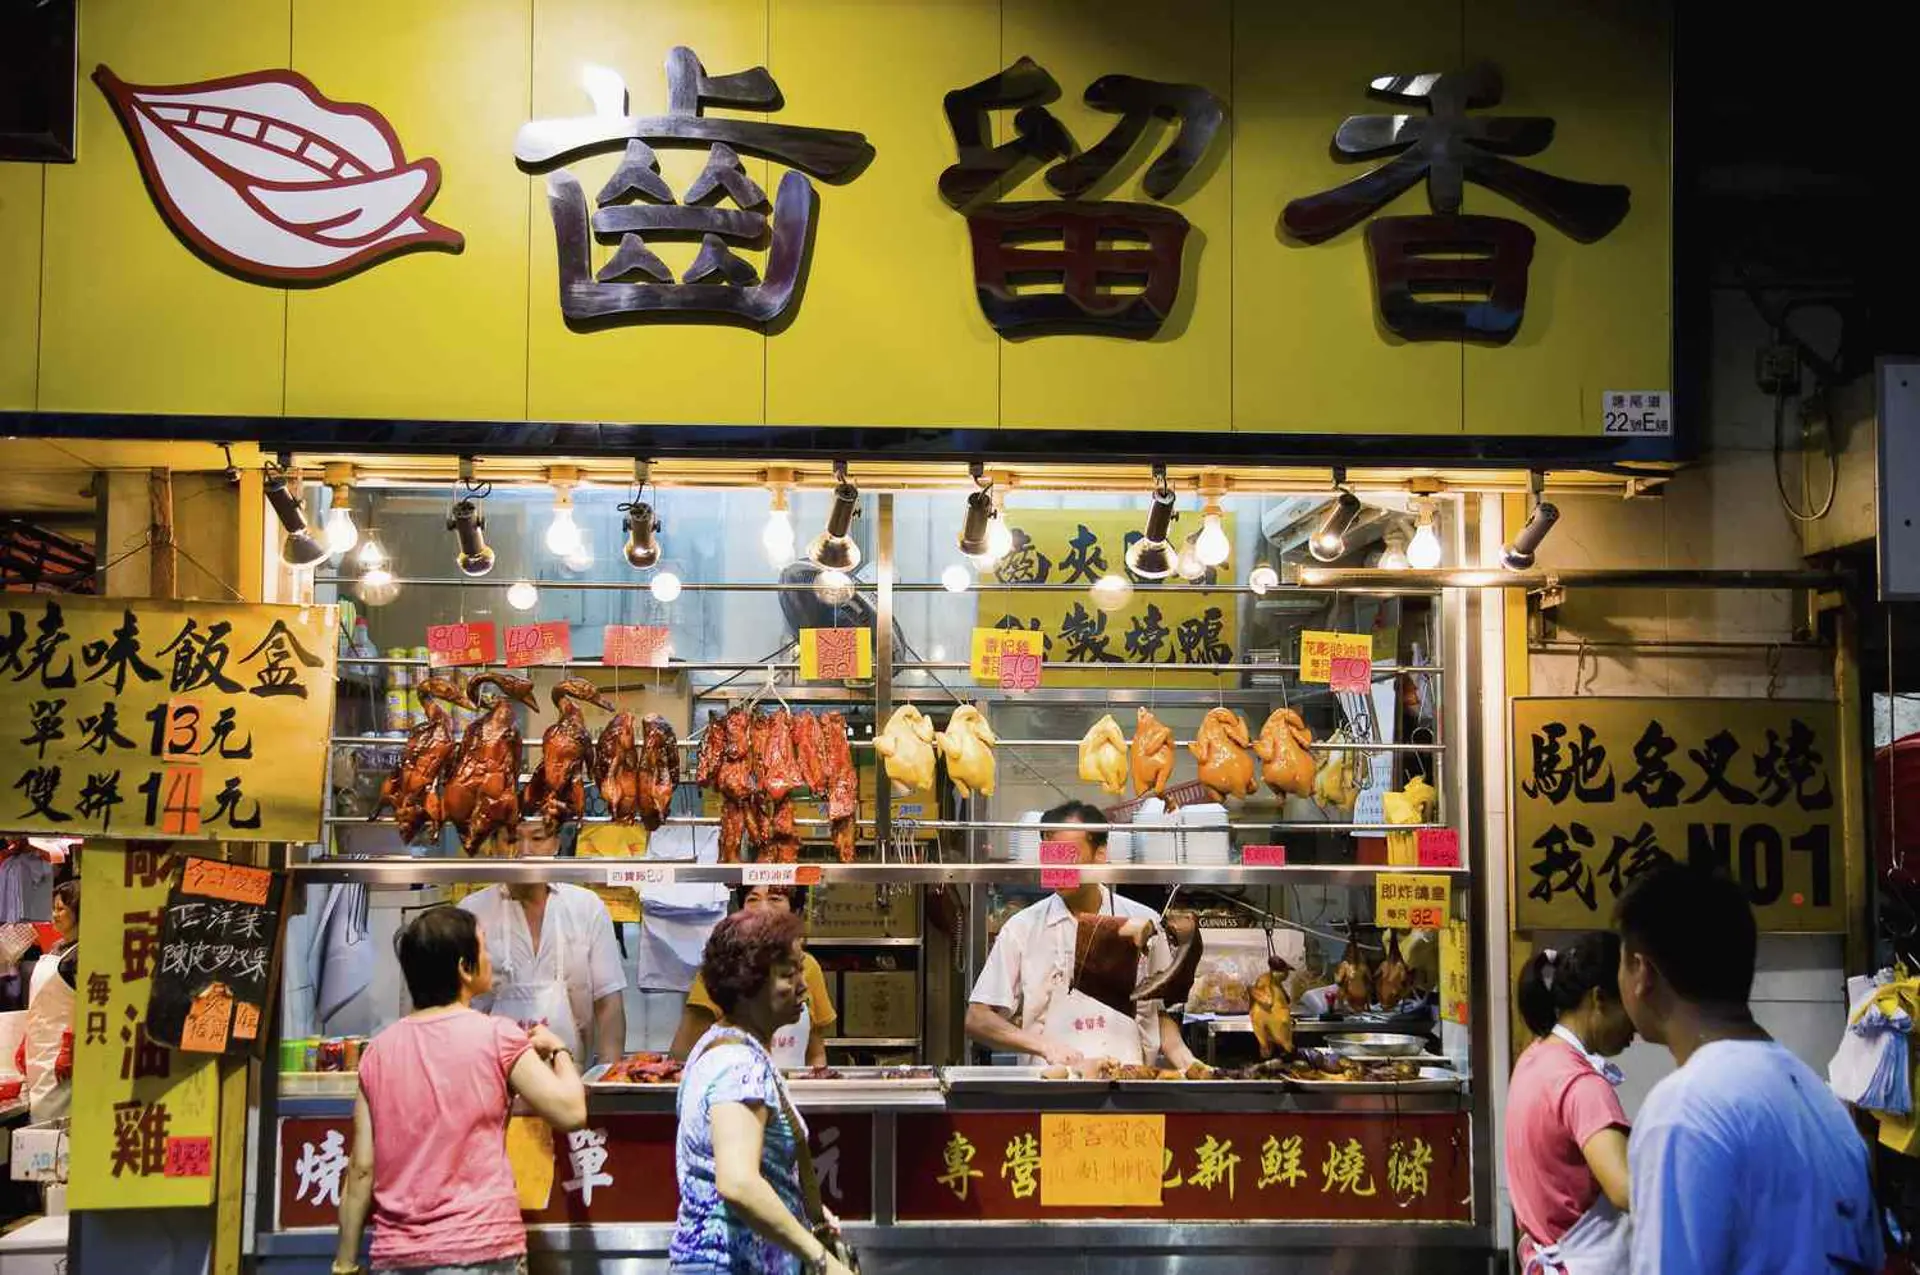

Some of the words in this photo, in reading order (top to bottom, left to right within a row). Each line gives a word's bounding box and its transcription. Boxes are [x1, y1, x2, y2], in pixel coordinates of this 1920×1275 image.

[514, 45, 1632, 346] 齒留香
[0, 600, 324, 699] 燒味飯盒
[1522, 719, 1834, 811] 馳名叉燒
[1199, 917, 1238, 928] GUINNESS
